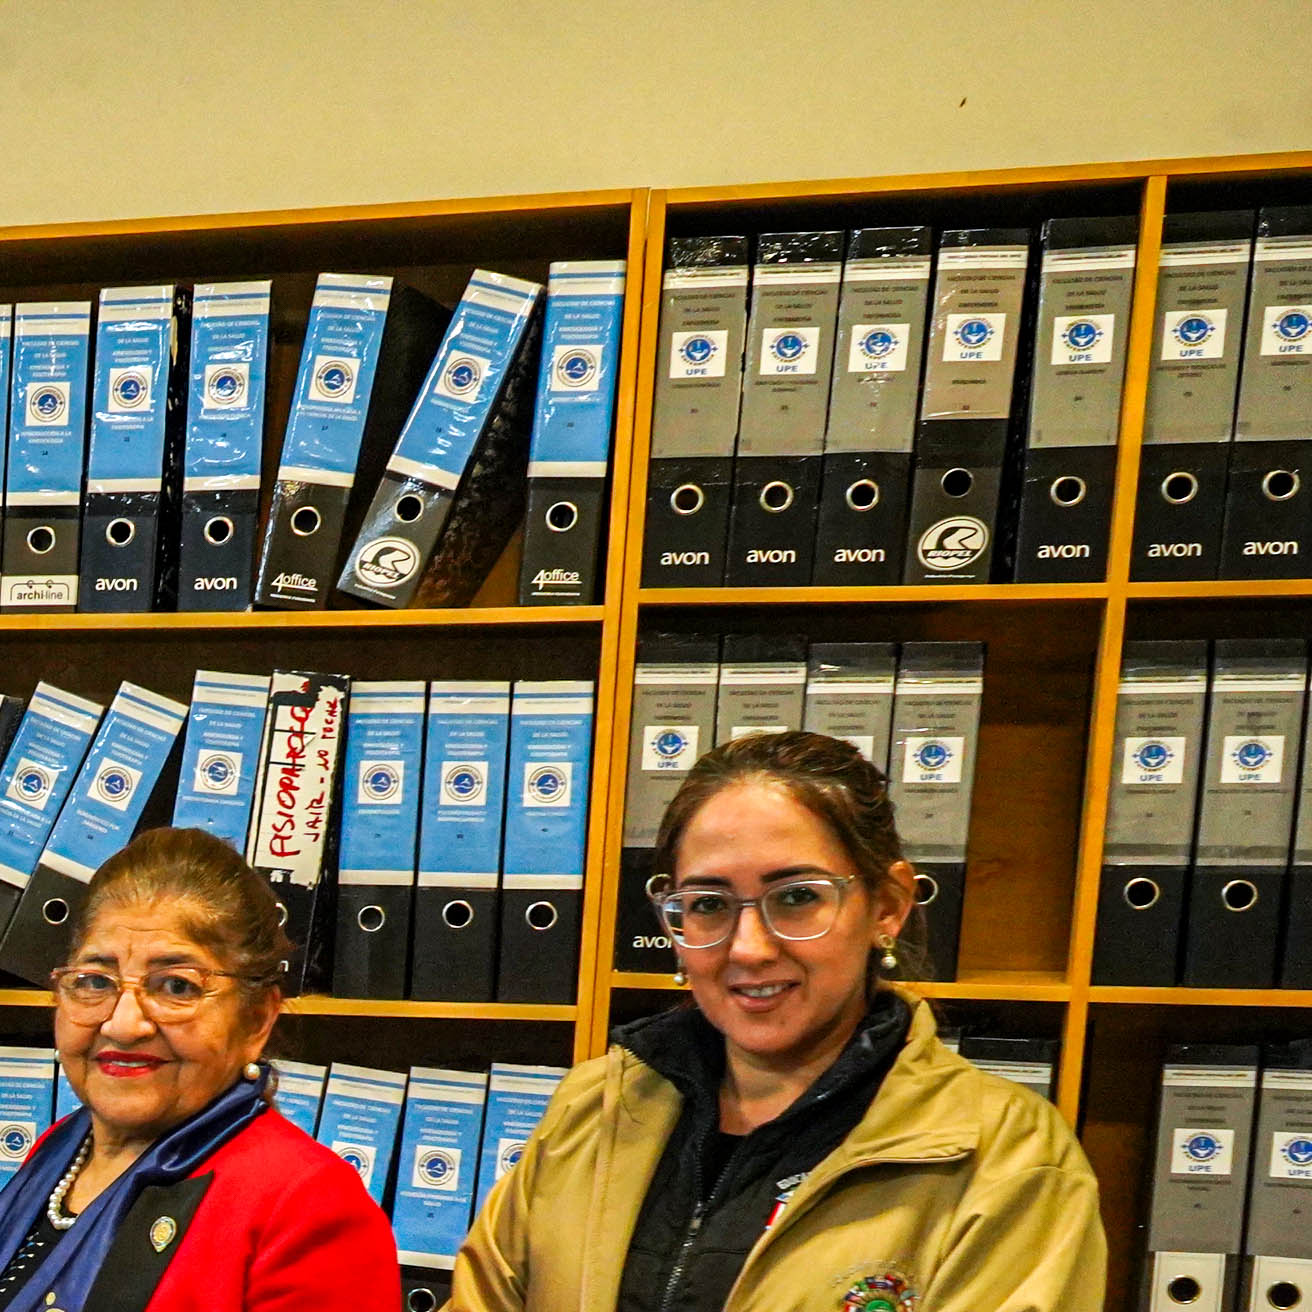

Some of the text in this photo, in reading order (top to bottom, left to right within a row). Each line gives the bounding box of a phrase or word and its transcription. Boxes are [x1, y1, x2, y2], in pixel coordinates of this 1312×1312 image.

[746, 548, 796, 563] avon
[834, 547, 885, 563] avon
[1037, 543, 1090, 559] avon
[1148, 541, 1202, 557] avon
[1243, 540, 1298, 555] avon
[661, 550, 710, 565] avon
[95, 575, 137, 591] avon
[193, 575, 237, 591] avon
